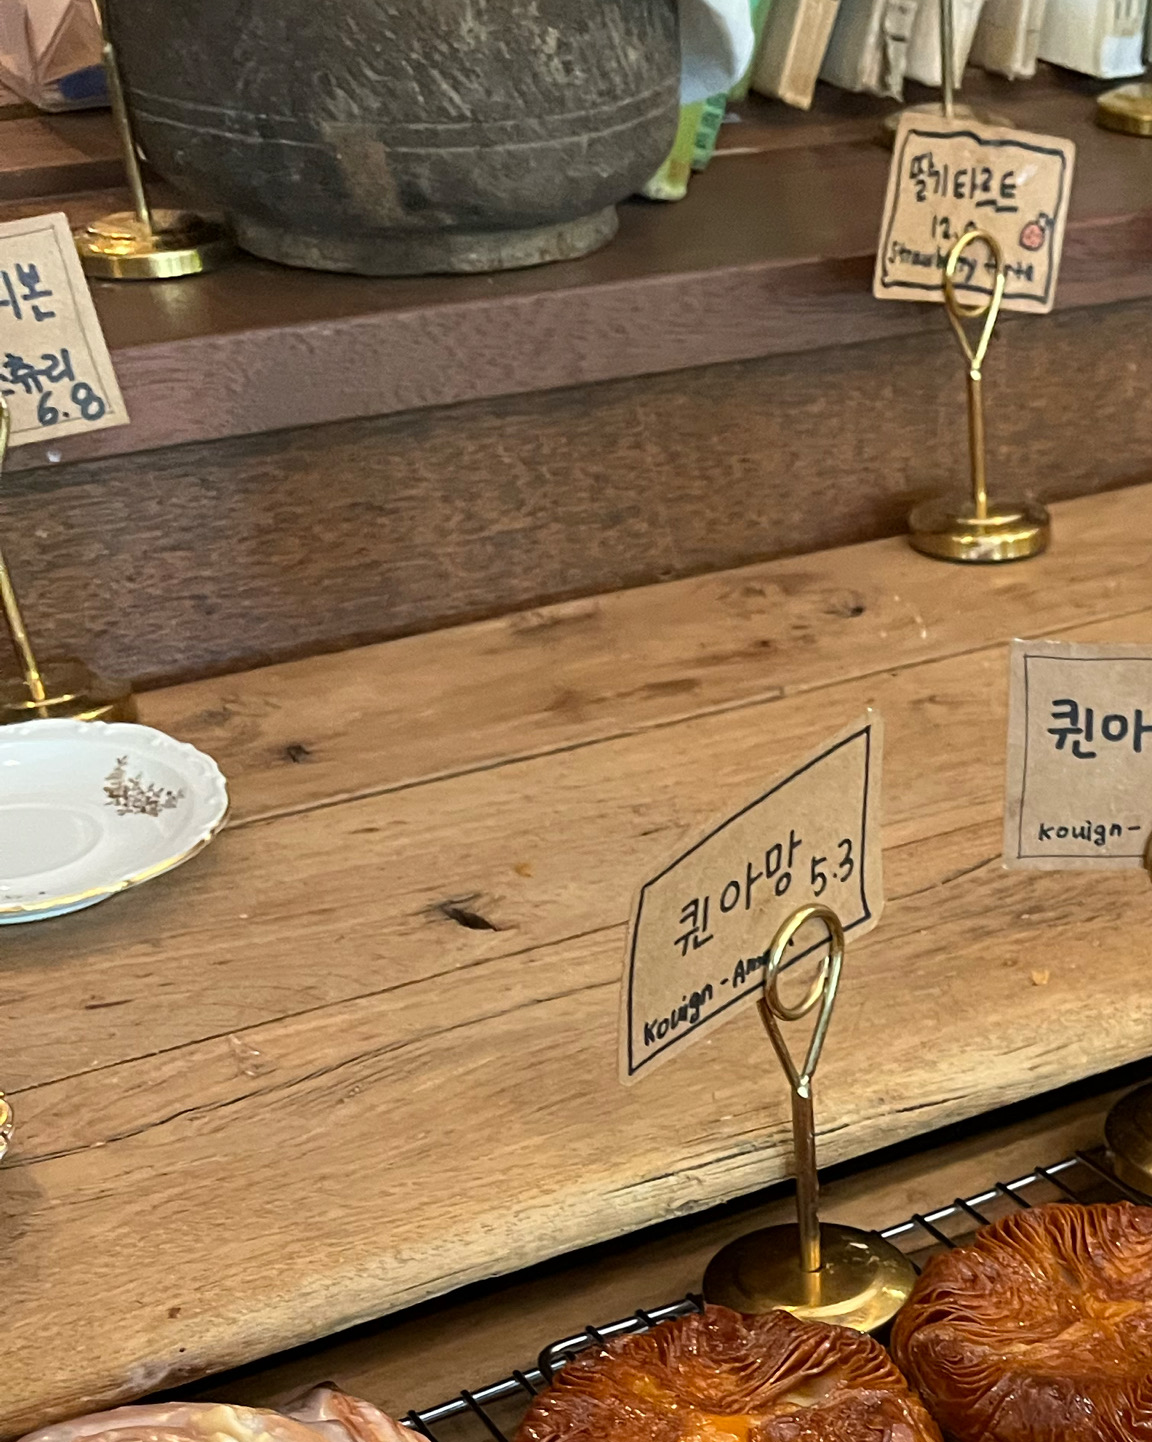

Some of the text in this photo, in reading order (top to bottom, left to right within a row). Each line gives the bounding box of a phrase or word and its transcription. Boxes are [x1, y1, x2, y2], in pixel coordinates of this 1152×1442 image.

[37, 381, 106, 427] 6.8
[673, 829, 854, 957] 퀸아망 5.3
